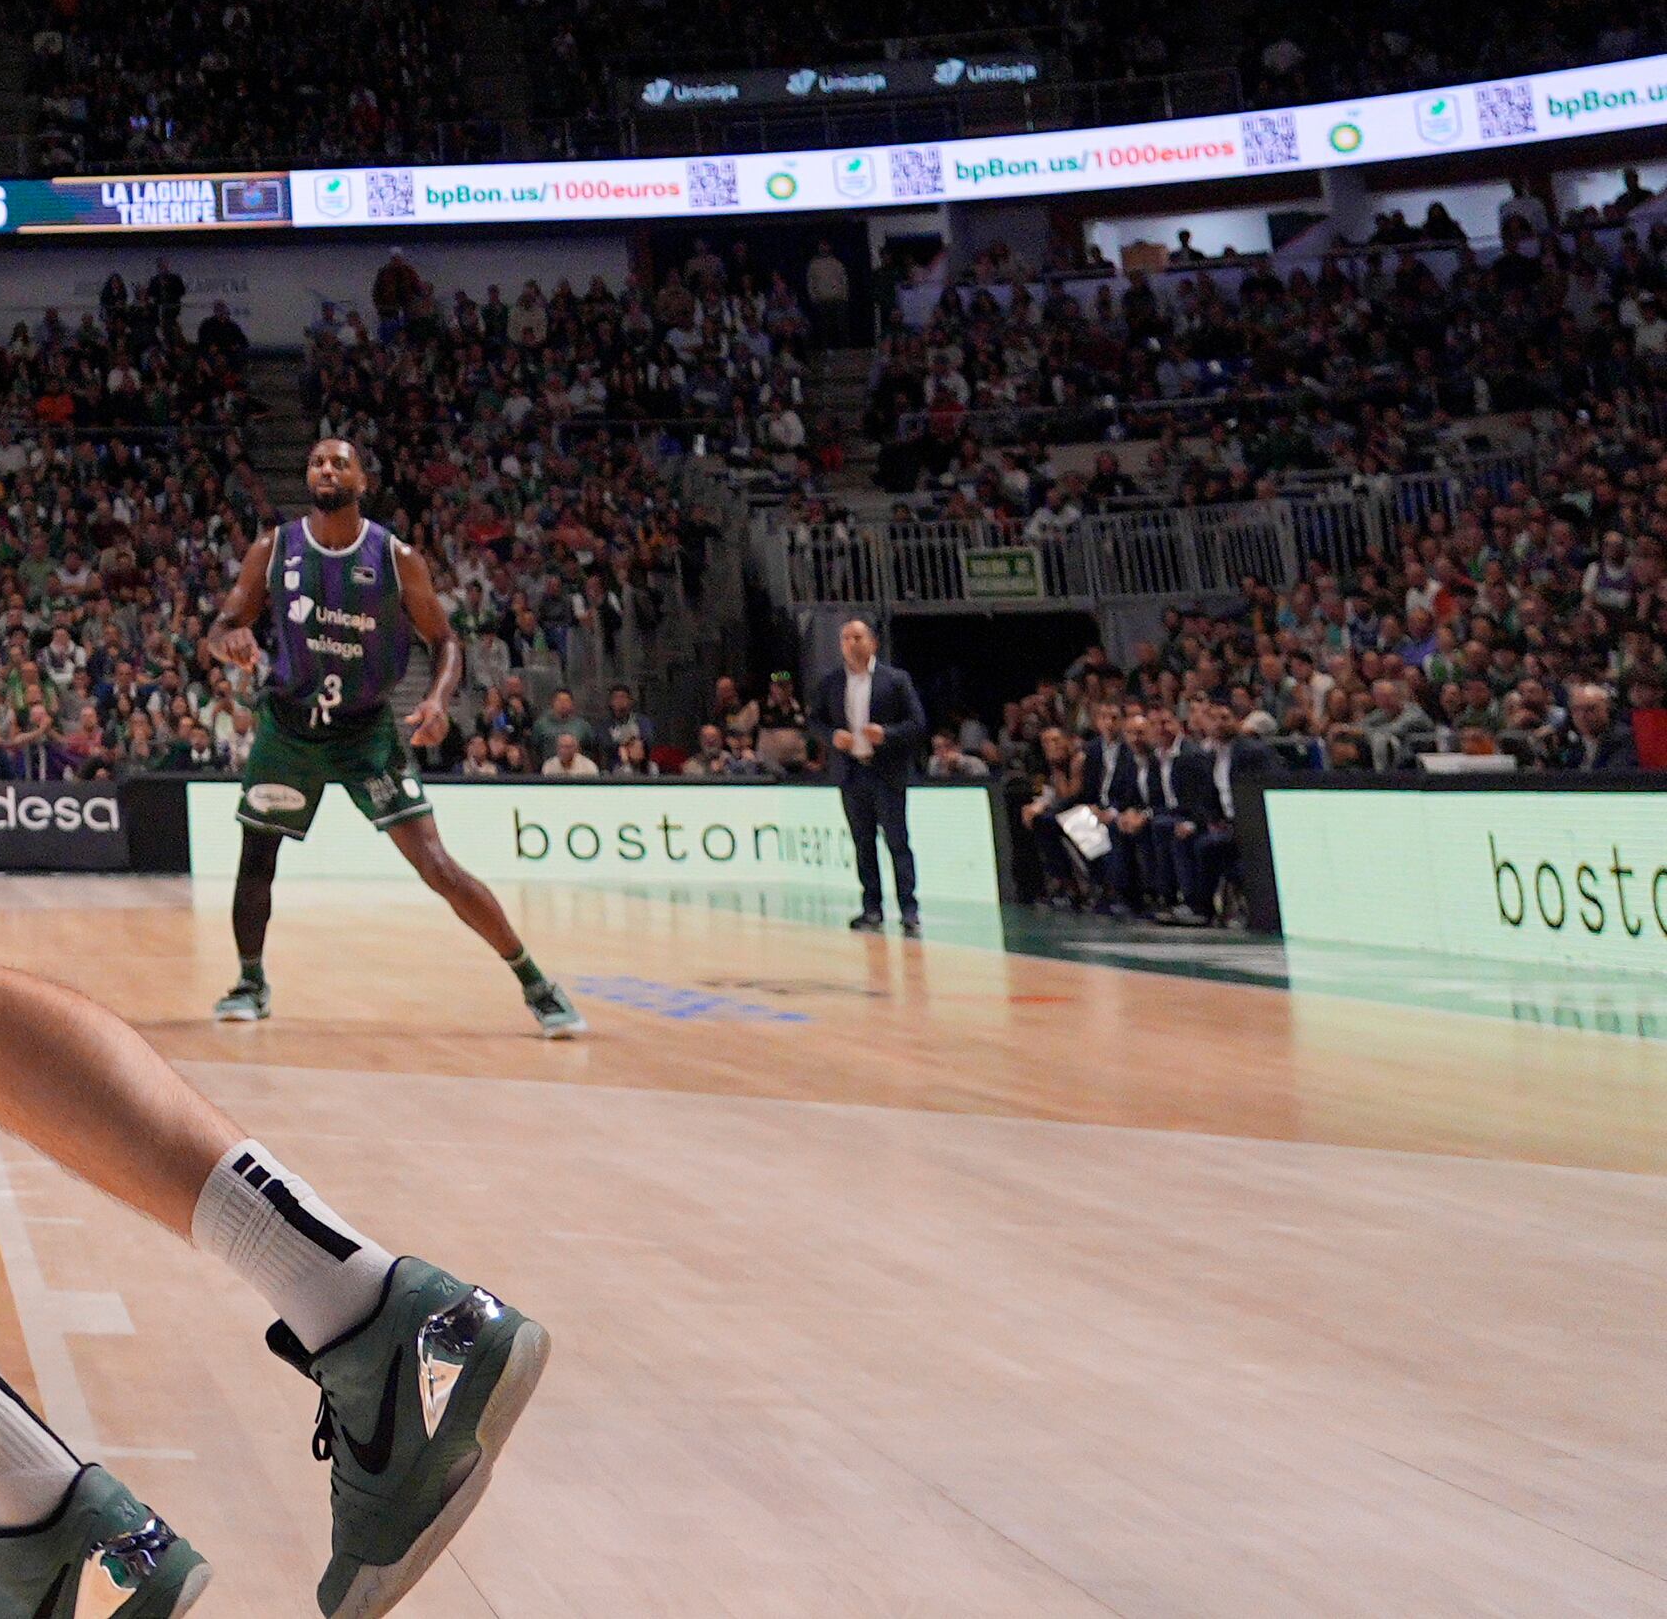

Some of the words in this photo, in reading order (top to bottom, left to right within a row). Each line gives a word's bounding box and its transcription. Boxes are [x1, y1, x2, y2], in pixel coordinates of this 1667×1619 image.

[955, 139, 1236, 185] bpBon.us/1000euros
[101, 183, 129, 207] LA
[132, 181, 216, 204] LAGUNA
[426, 181, 681, 209] bpBon.us/1000euros
[117, 201, 217, 225] TENERIFE
[315, 605, 376, 632] Unicaja
